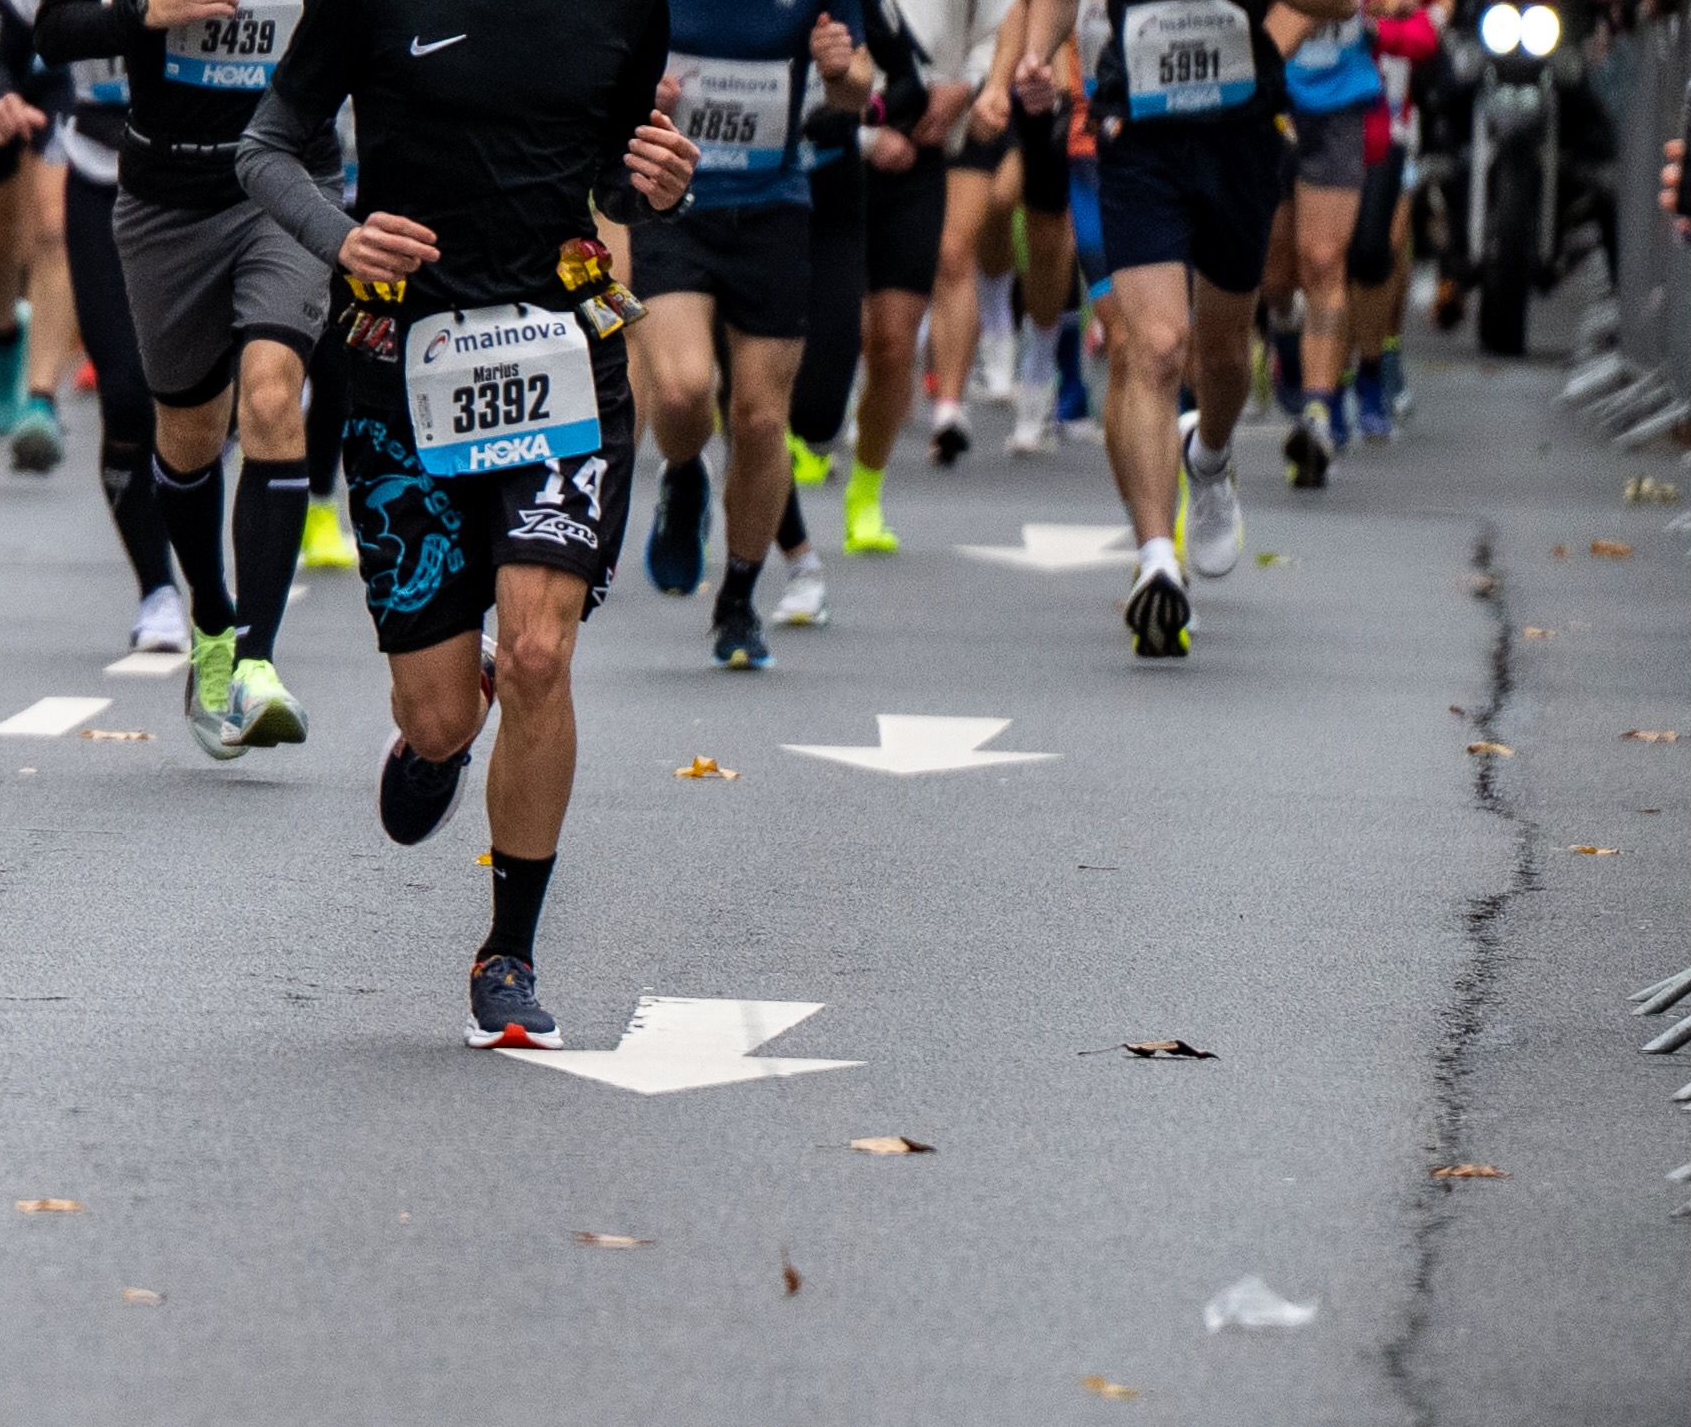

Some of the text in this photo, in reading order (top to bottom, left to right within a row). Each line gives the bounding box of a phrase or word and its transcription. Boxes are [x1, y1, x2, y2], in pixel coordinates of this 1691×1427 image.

[201, 20, 276, 55] 3439
[202, 64, 268, 87] HOKA
[1160, 48, 1220, 85] 5991
[688, 109, 758, 143] 8855
[455, 321, 567, 353] mainova
[474, 362, 520, 384] Marius
[453, 373, 550, 434] 3392
[470, 433, 552, 470] HOKA
